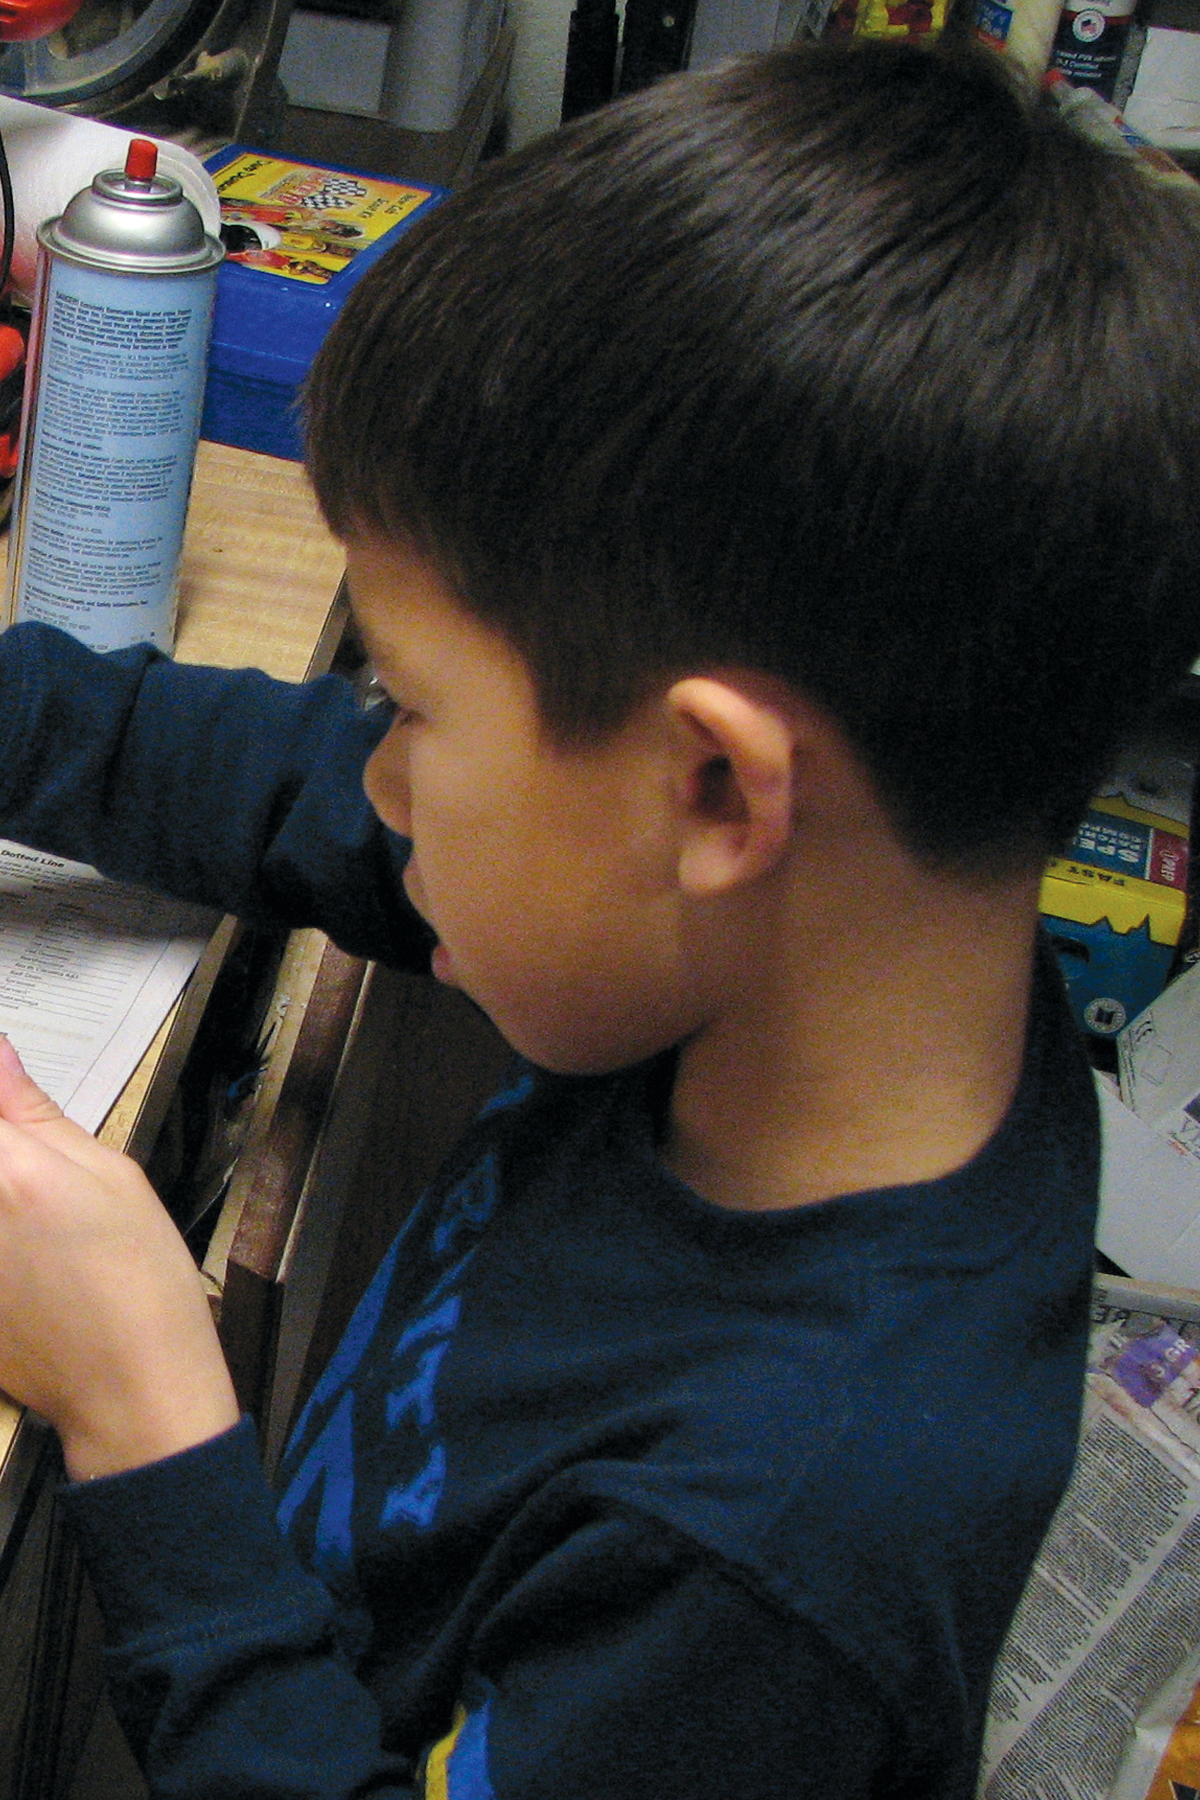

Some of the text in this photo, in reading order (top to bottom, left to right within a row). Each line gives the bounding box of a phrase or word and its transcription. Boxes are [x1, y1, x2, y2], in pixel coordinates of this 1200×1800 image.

[1, 850, 38, 862] Dotted
[41, 859, 64, 868] Line
[1072, 837, 1140, 863] SPE
